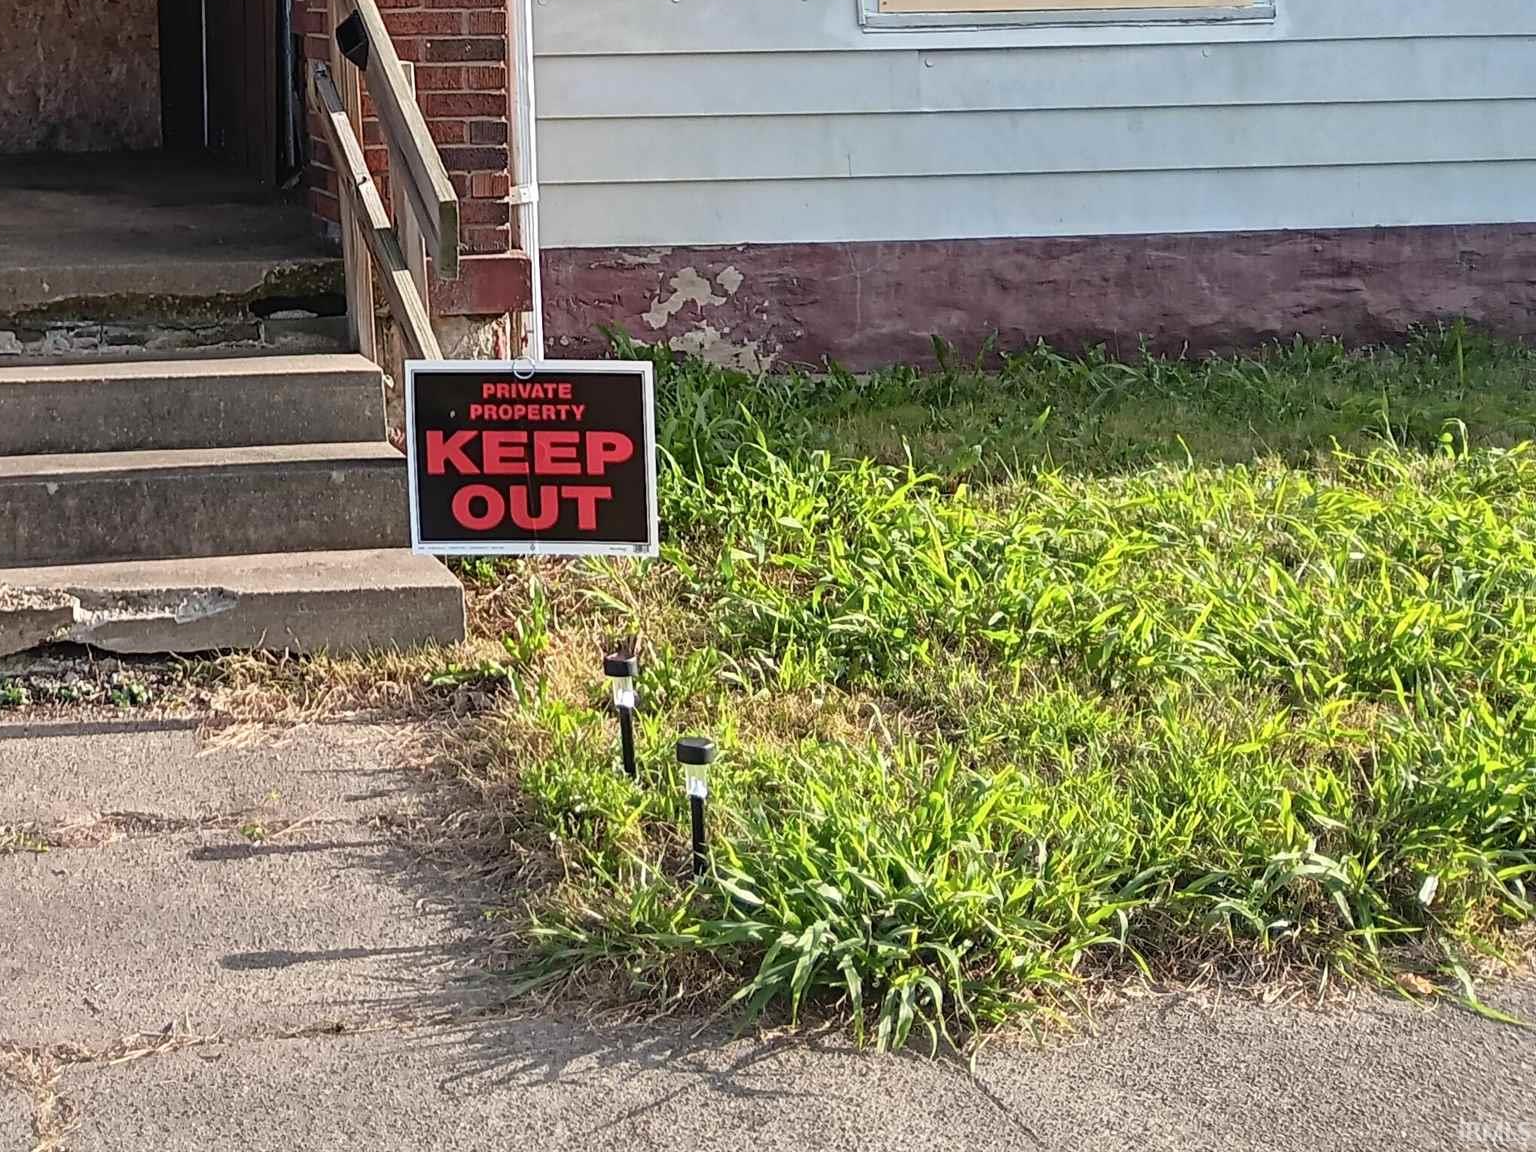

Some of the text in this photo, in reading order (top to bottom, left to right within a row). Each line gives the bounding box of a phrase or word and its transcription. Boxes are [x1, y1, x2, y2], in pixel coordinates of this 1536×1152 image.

[482, 382, 572, 400] PRIVATE
[469, 404, 586, 421] PROPERTY
[425, 430, 634, 476] KEEP
[451, 484, 613, 532] OUT
